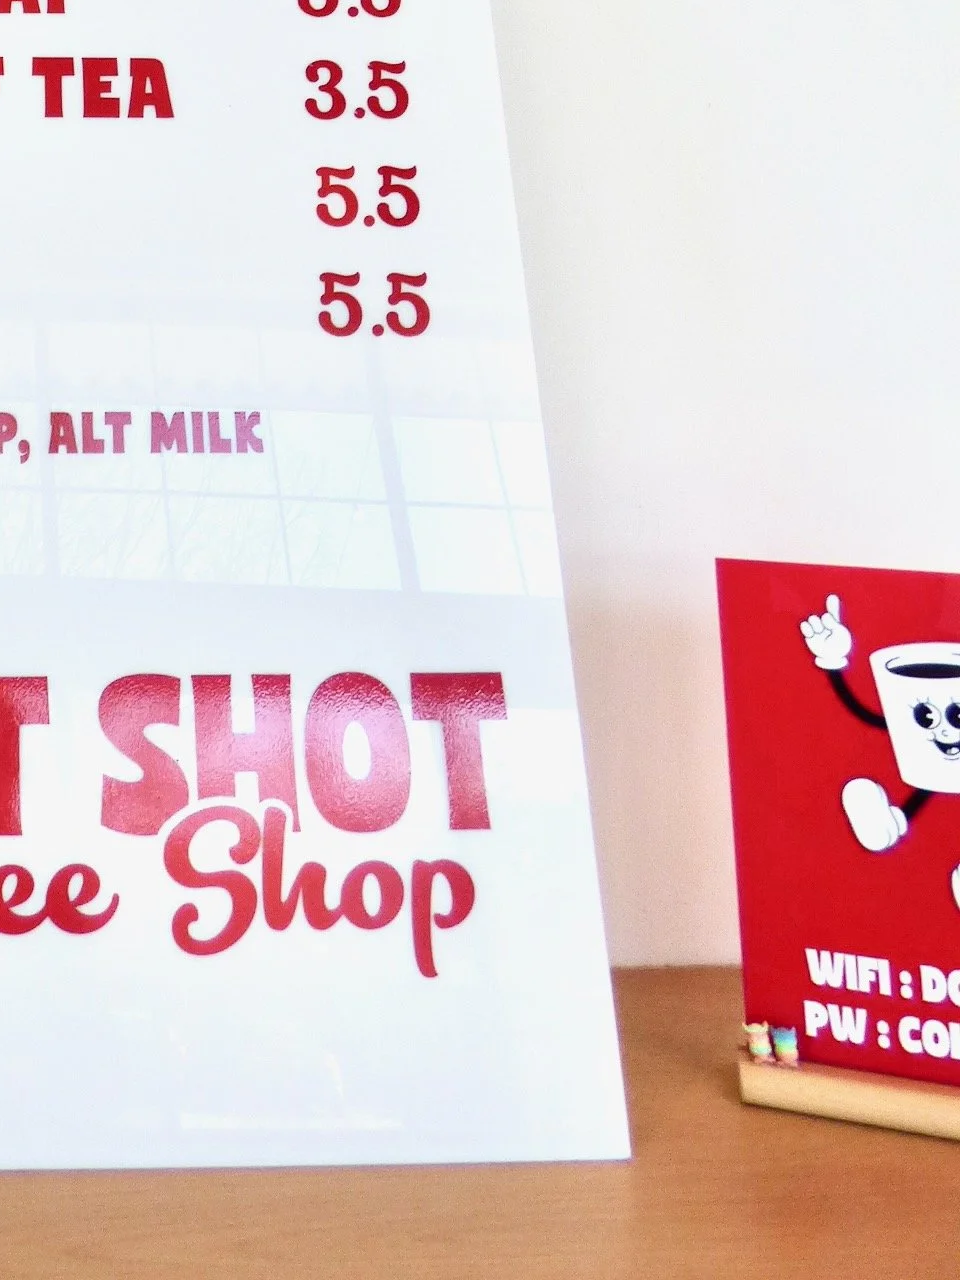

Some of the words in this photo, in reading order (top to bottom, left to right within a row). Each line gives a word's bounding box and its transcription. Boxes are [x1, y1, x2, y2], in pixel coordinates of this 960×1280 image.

[31, 57, 175, 120] TEA
[303, 59, 410, 121] 3.5
[315, 165, 421, 228] 5.5
[317, 271, 431, 339] 5.5
[48, 411, 133, 456] ALT
[149, 411, 265, 455] MILK
[97, 671, 508, 837] SHOT
[162, 805, 477, 979] Shop
[804, 947, 892, 997] WIFI
[803, 999, 868, 1045] PW
